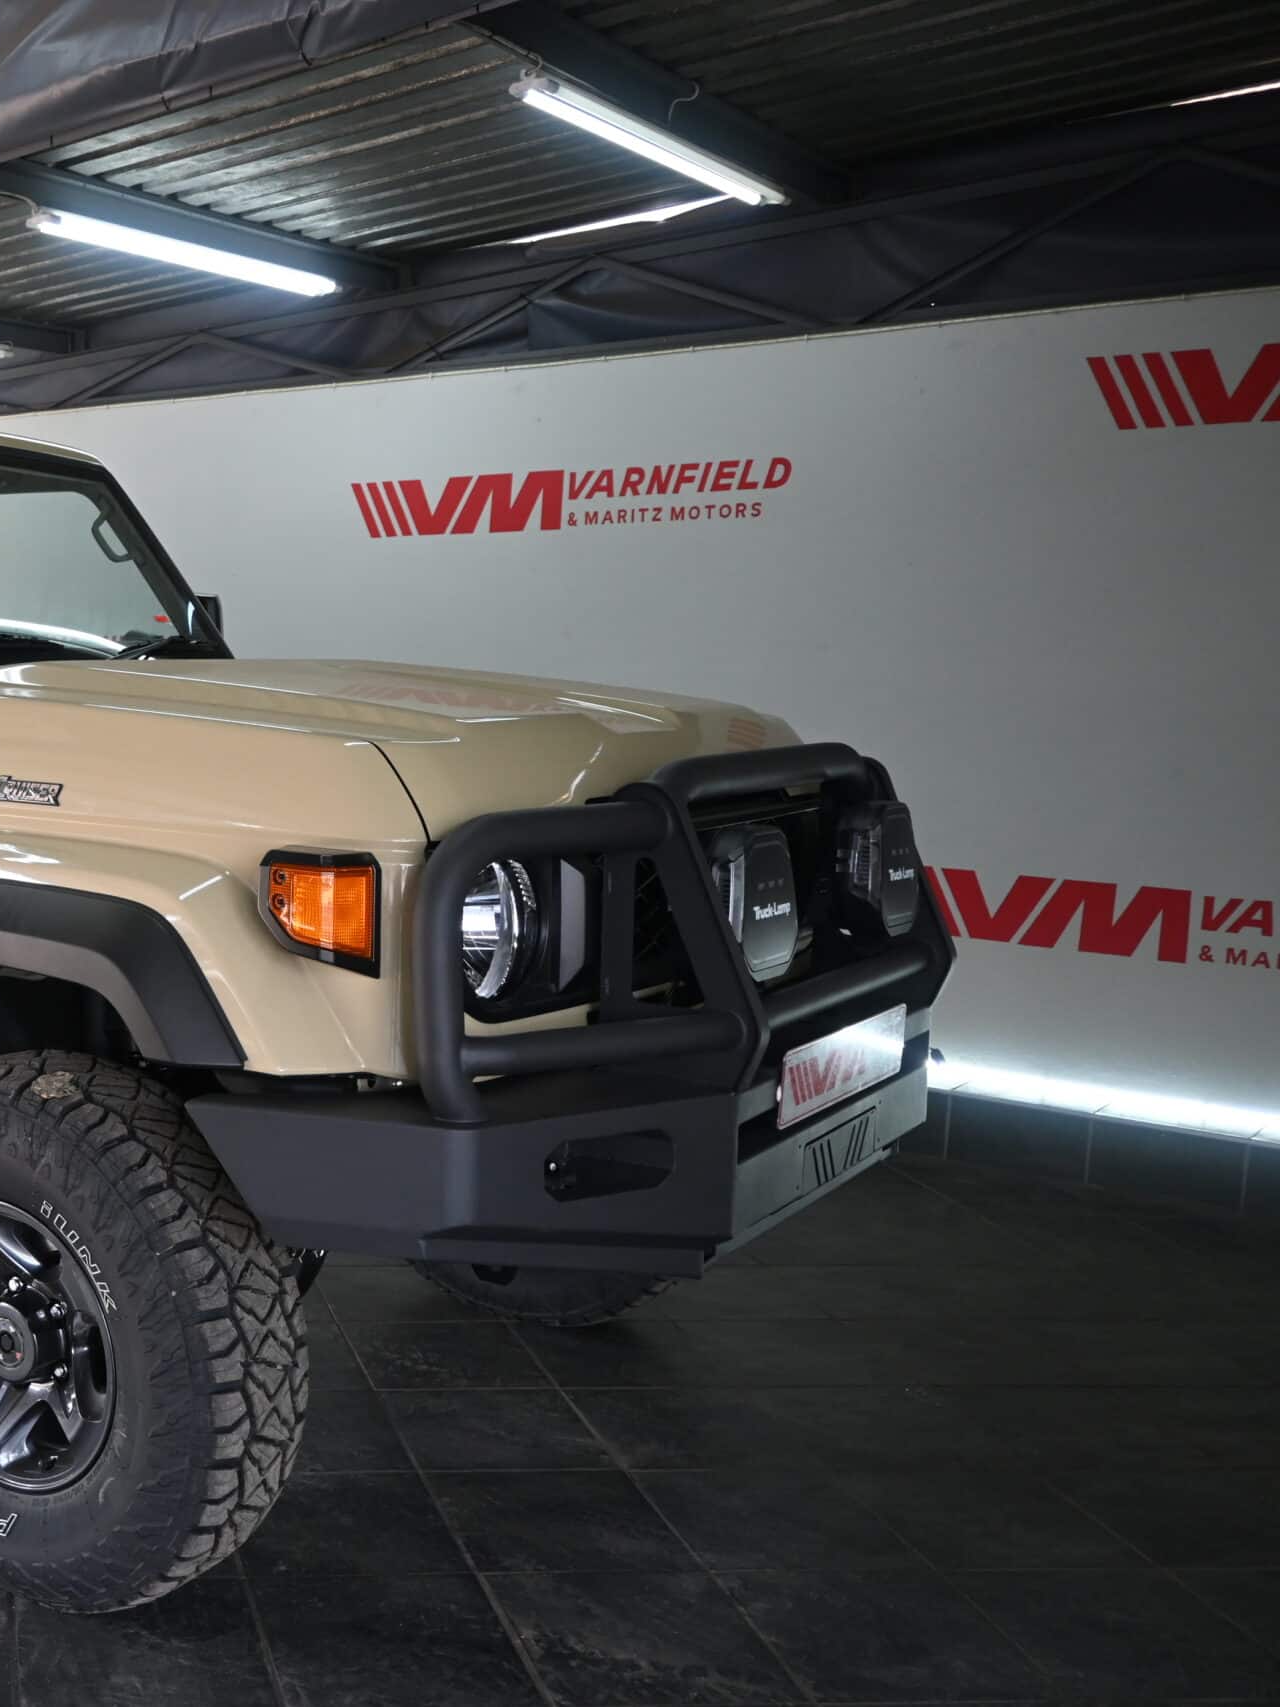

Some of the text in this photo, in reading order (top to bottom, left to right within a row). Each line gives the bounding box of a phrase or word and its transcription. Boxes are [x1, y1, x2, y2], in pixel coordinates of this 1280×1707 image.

[568, 457, 792, 500] VARNFIELD
[398, 469, 564, 536] VM
[568, 502, 763, 527] & MARITZ MOTORS
[941, 868, 1192, 963] VM
[1199, 945, 1214, 962] &
